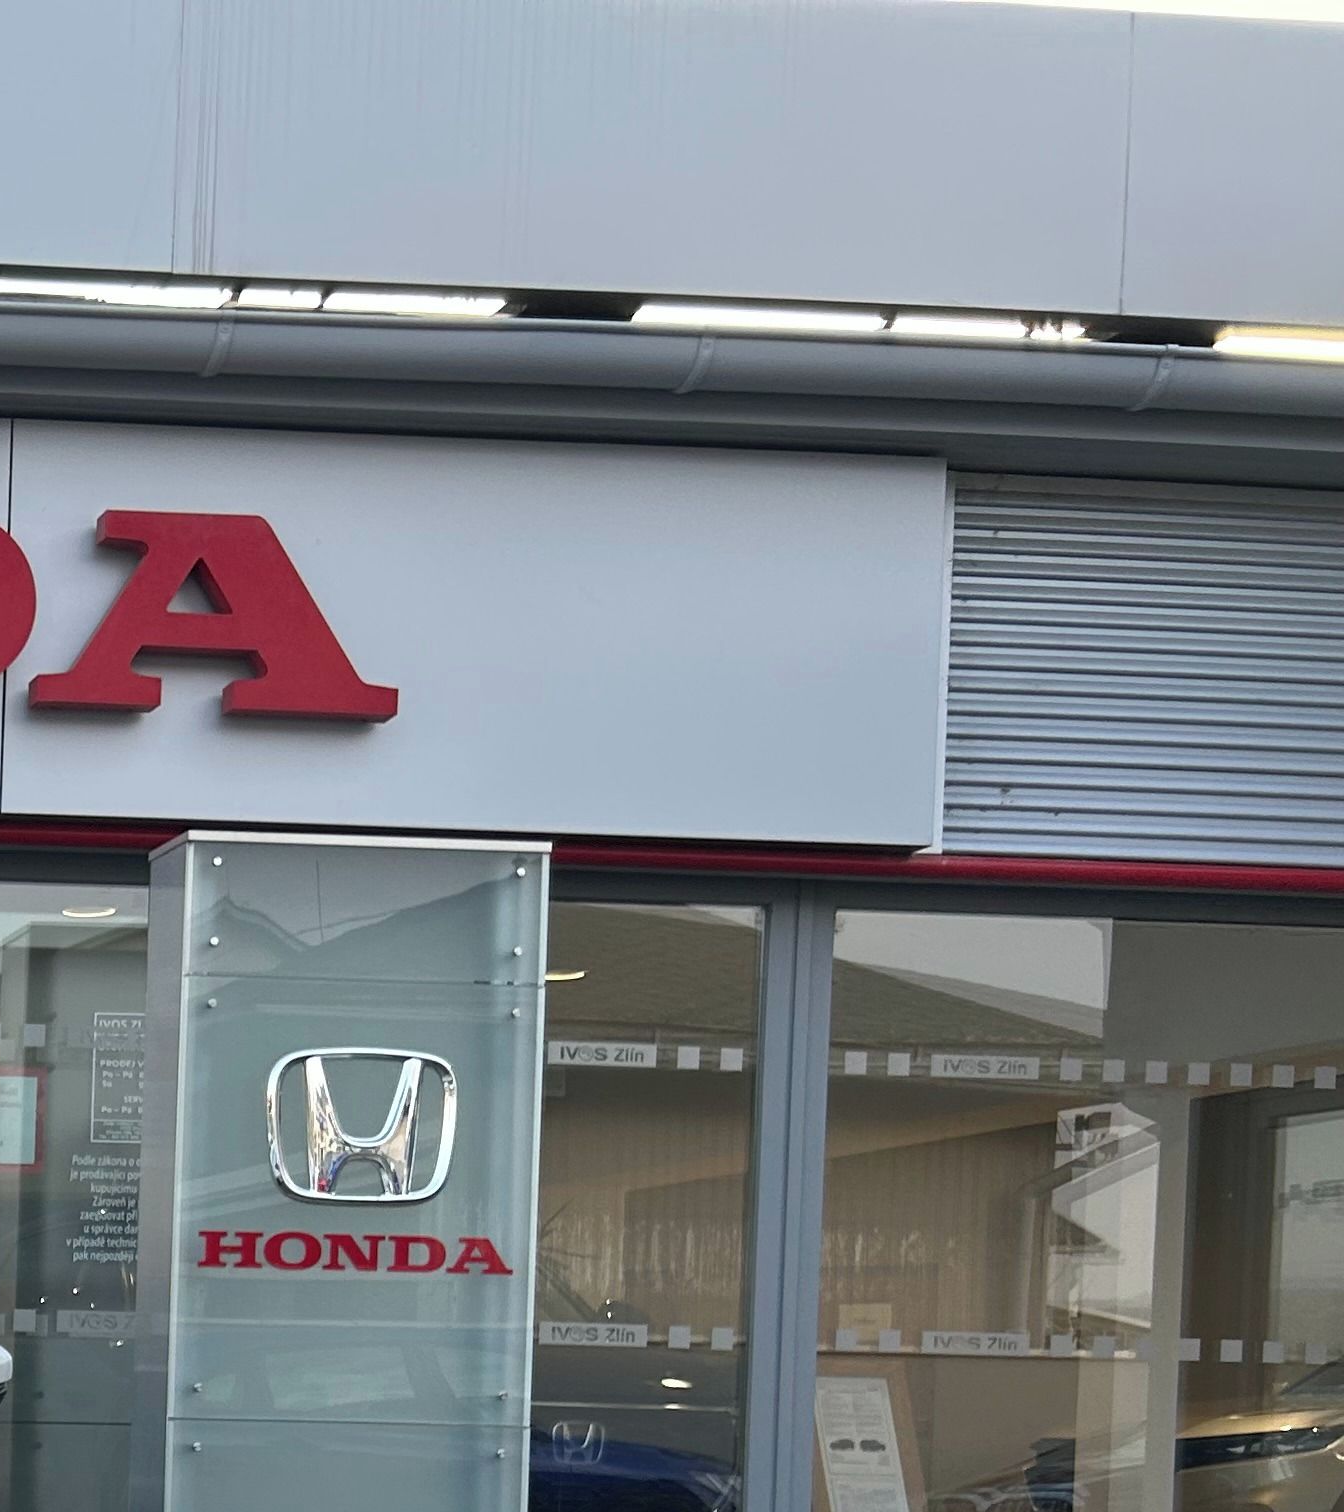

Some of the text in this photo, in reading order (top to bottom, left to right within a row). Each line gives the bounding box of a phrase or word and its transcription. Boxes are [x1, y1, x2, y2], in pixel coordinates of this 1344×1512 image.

[560, 1045, 644, 1063] IVOS Zlín
[943, 1058, 1027, 1075] IVOS Zlín
[198, 1231, 513, 1275] HONDA
[552, 1326, 636, 1343] IVOS Zlín
